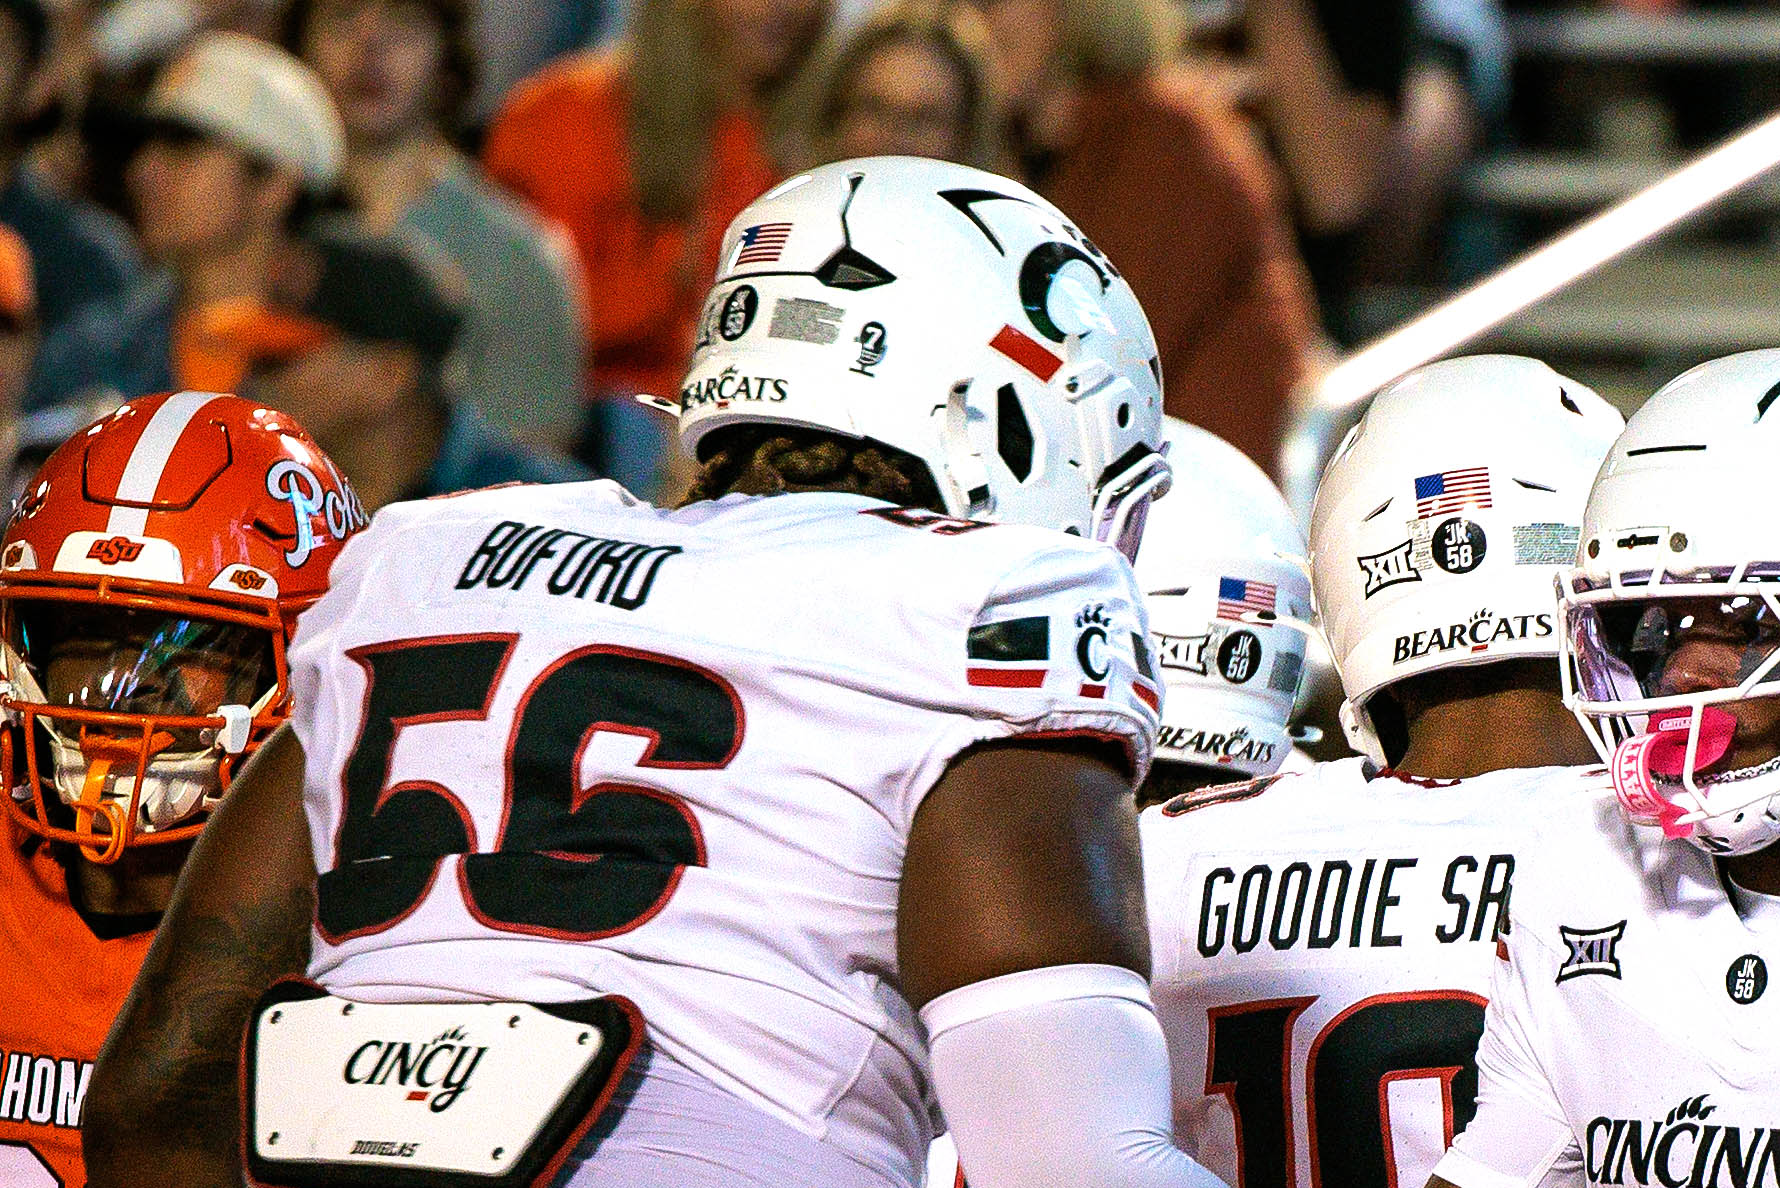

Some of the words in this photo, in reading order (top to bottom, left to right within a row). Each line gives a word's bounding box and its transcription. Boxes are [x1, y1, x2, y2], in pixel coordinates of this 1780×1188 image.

[681, 364, 789, 414] EARCATS
[86, 536, 145, 565] OSU
[454, 520, 684, 612] BUFORD
[1446, 544, 1474, 570] 58
[1392, 607, 1553, 665] BEARCATS
[1225, 655, 1250, 680] 58
[1157, 725, 1277, 763] BEARCATS
[316, 631, 747, 947] 56
[1197, 857, 1419, 958] GOODIE
[1435, 854, 1516, 943] SR
[1737, 958, 1758, 979] JK
[1733, 978, 1755, 999] 58
